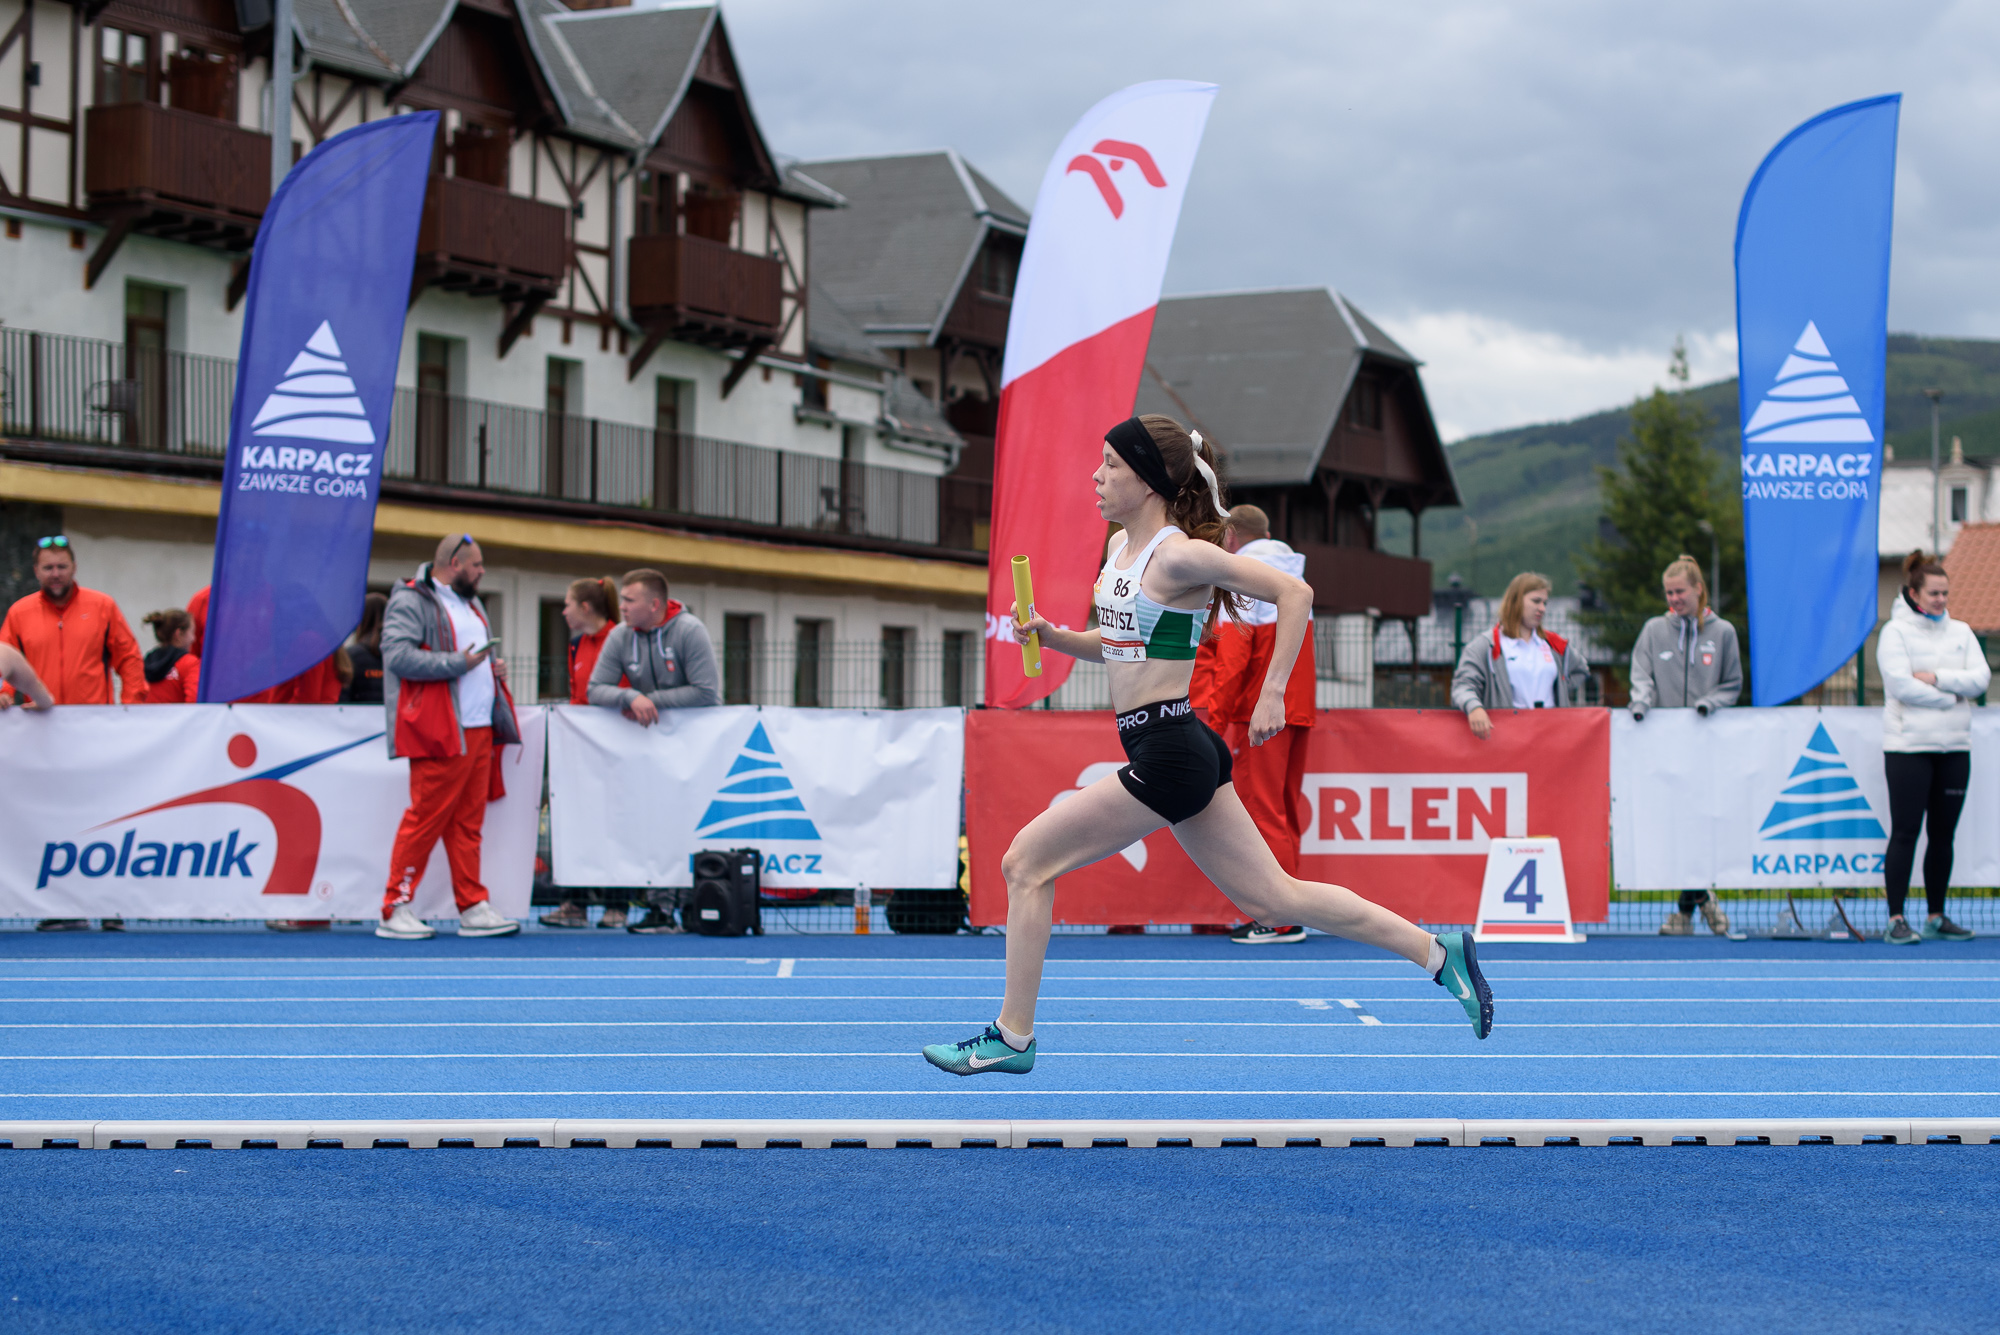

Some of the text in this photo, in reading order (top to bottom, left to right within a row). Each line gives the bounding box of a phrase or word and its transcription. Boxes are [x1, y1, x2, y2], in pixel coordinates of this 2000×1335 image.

[241, 446, 373, 477] KARPACZ
[1741, 453, 1872, 477] KARPACZ
[238, 473, 367, 500] ZAWSZE GÓRĄ
[1114, 577, 1131, 598] 86
[1160, 699, 1192, 718] NIKE
[1300, 787, 1507, 841] RLEN
[36, 829, 260, 890] polanik
[1752, 854, 1886, 875] KARPACZ
[1504, 859, 1543, 915] 4
